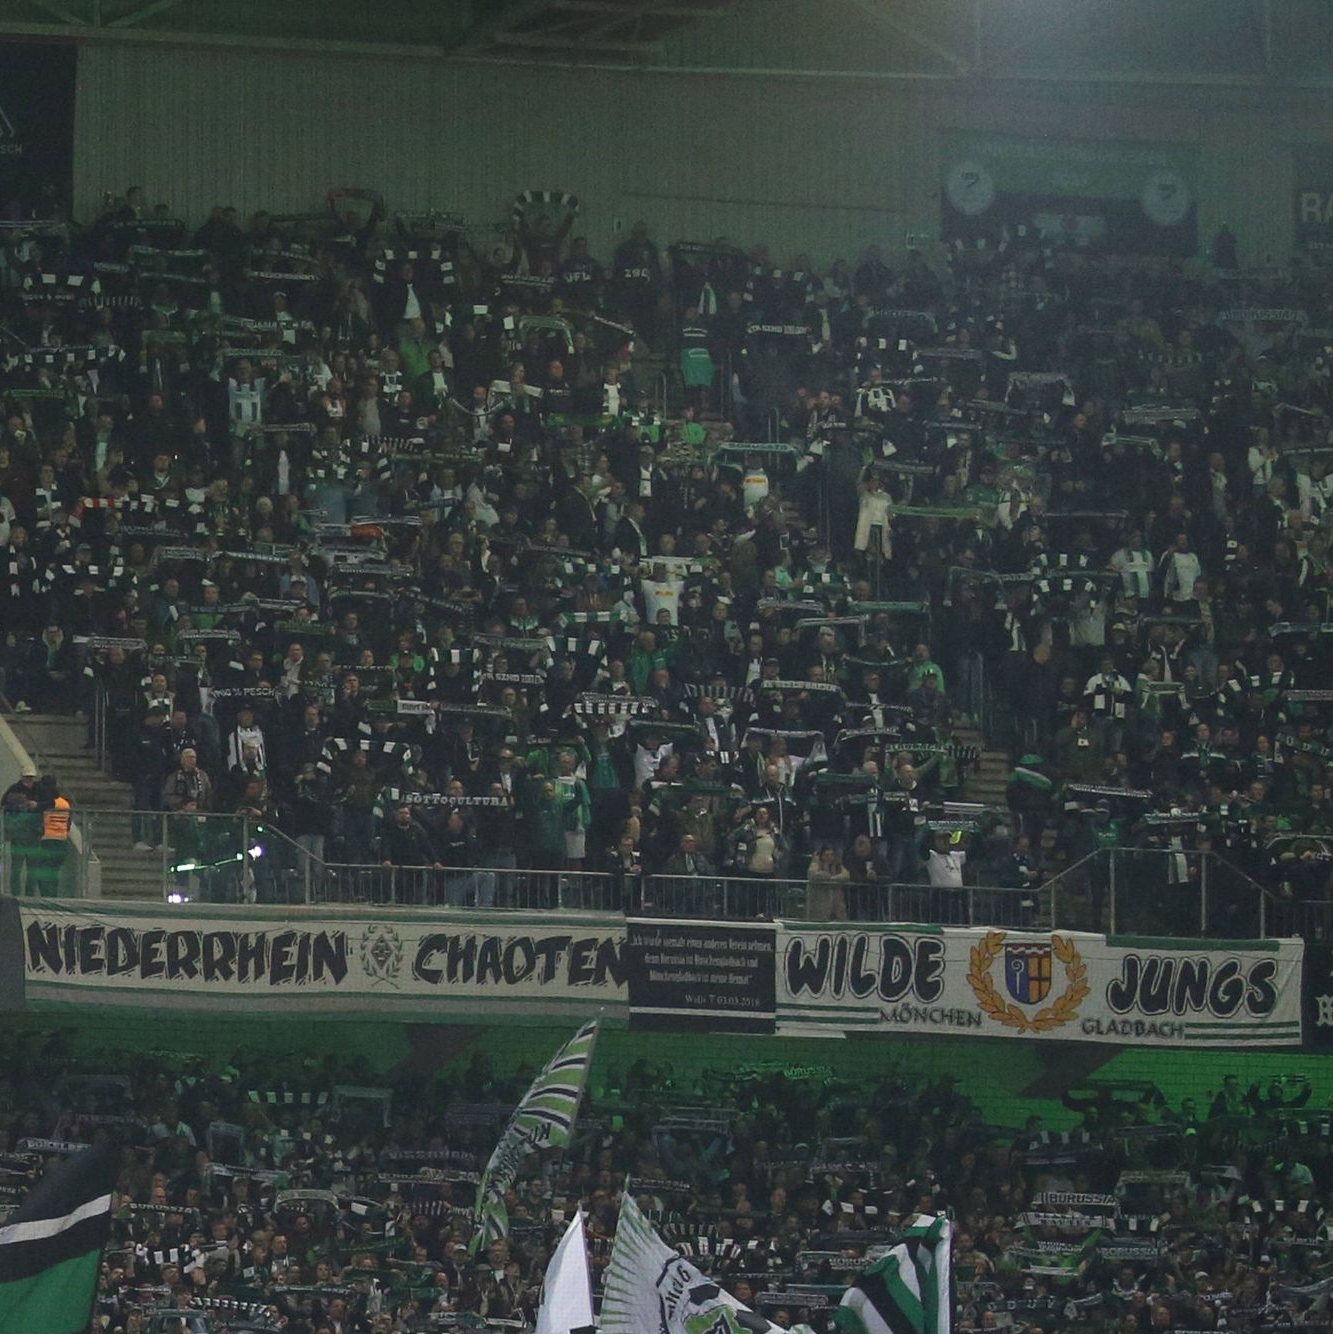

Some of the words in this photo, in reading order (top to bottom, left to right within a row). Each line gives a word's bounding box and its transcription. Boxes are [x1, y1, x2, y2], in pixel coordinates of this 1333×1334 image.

[402, 793, 510, 807] SOTTOCULTURA
[26, 920, 349, 986] NIEDERRHEIN
[412, 932, 630, 989] CHAOTEN
[786, 932, 945, 1003] WILDE
[1106, 954, 1279, 1019] JUNGS
[879, 1004, 982, 1027] MÖNCHEN
[1081, 1018, 1184, 1040] GLADBACH
[1048, 1194, 1119, 1206] BORUSSIA
